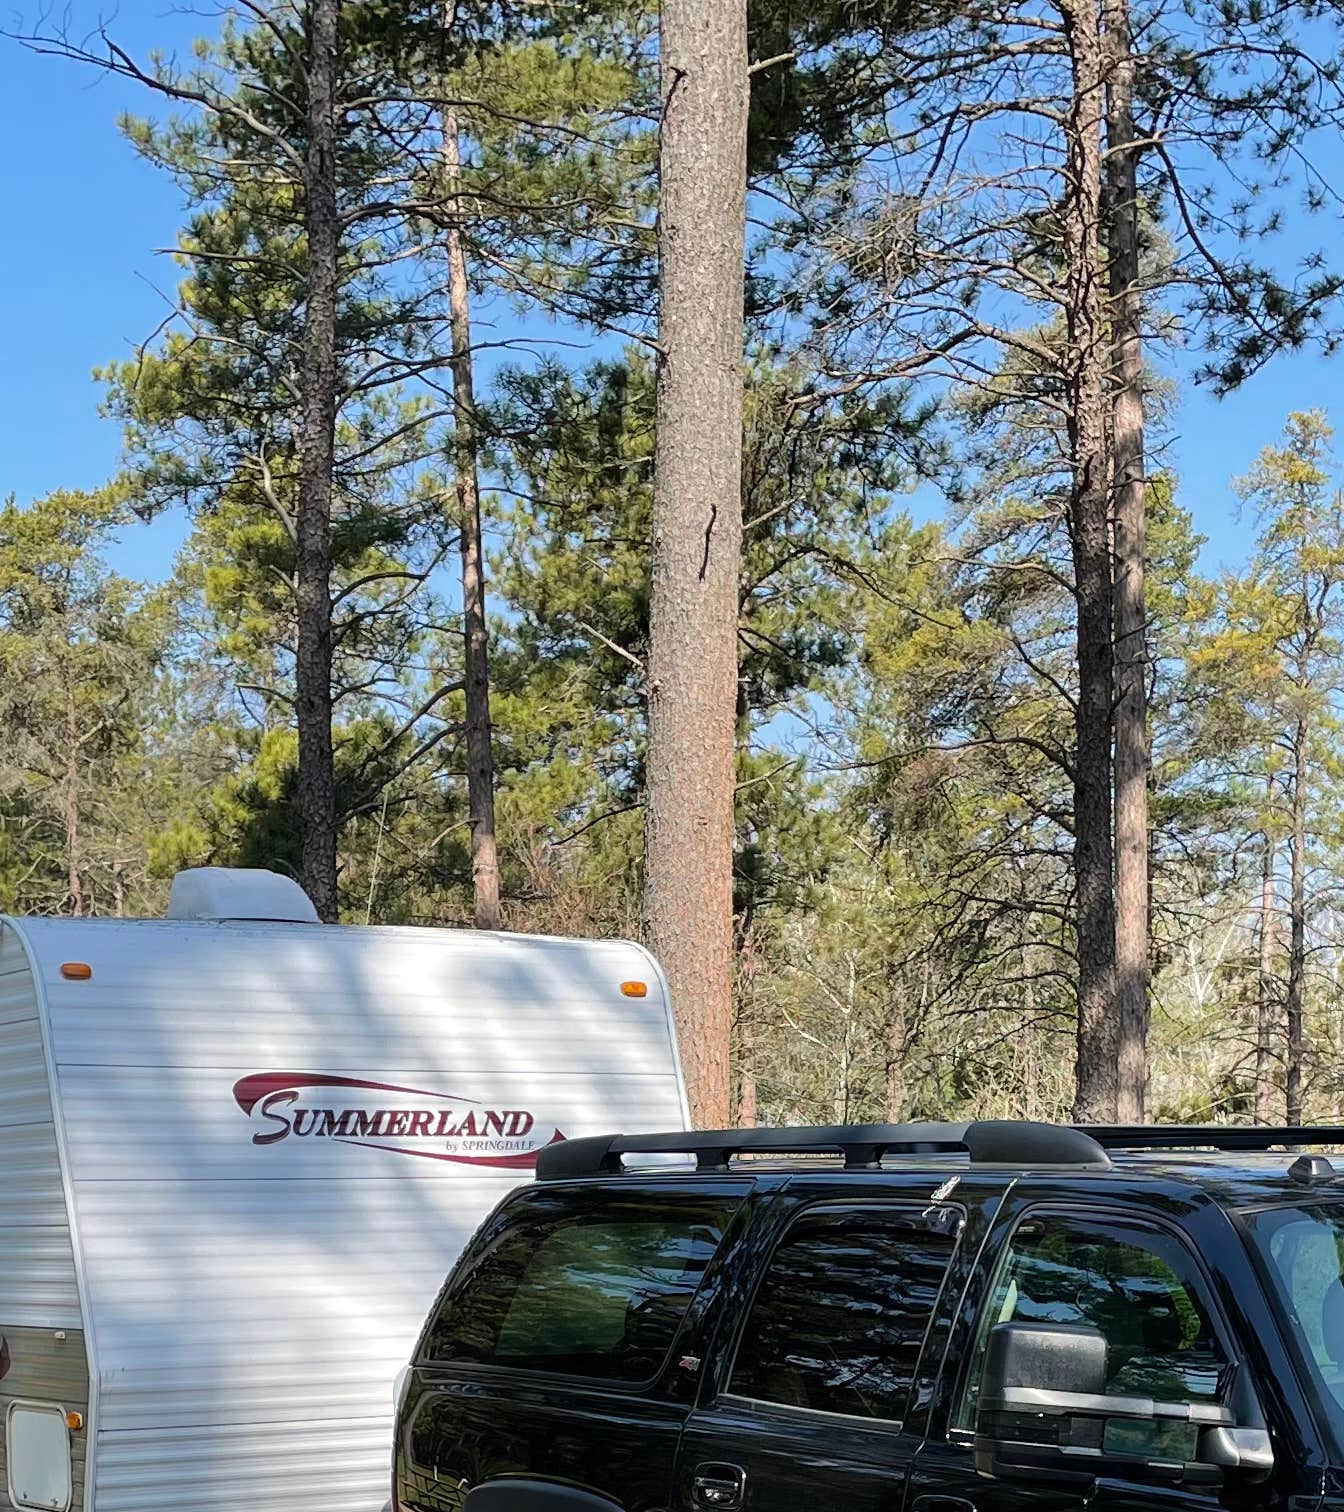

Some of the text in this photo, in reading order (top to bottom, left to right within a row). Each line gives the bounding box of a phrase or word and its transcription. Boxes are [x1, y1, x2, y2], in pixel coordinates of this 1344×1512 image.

[252, 1090, 534, 1145] SUMMERLAND
[445, 1140, 536, 1153] by SPRINGDALE
